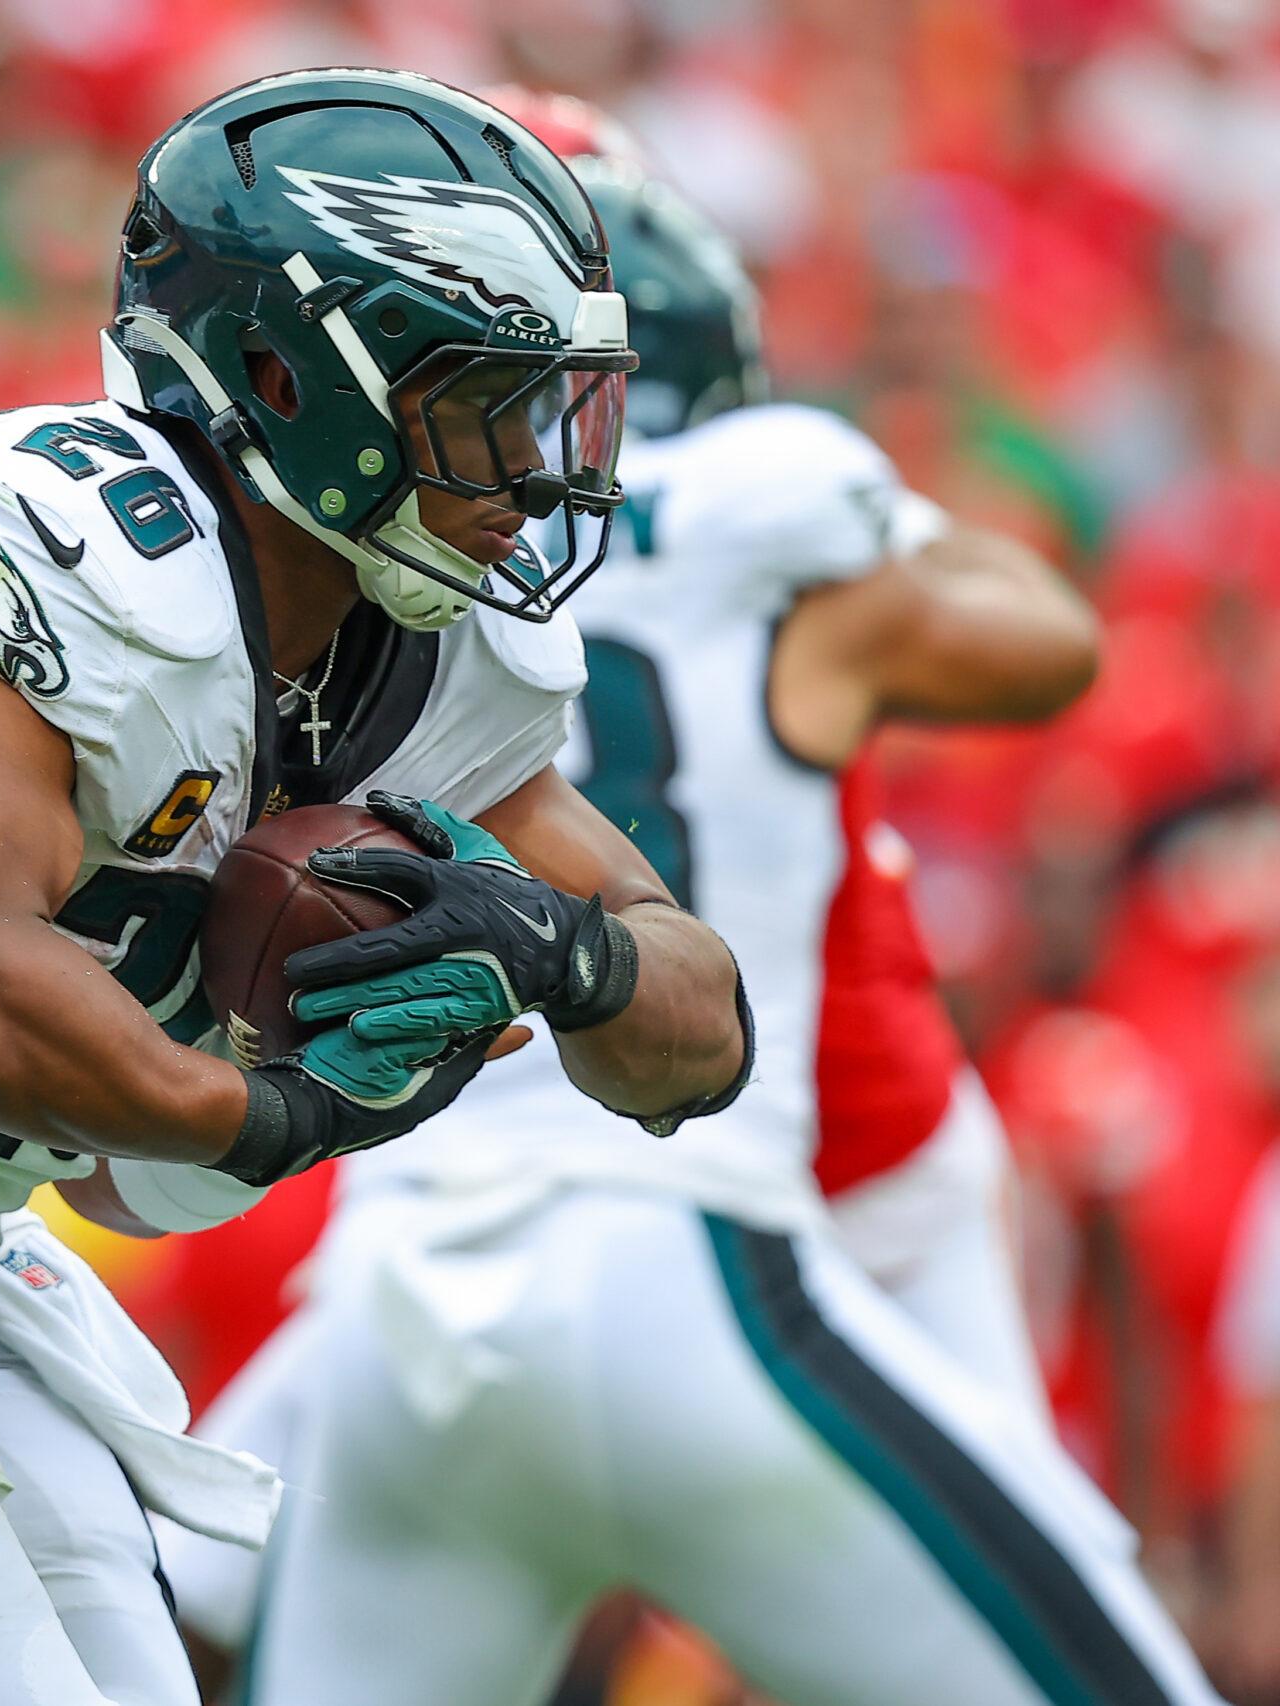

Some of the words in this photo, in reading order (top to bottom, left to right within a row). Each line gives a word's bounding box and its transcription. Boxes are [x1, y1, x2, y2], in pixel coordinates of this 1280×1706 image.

[496, 325, 560, 346] OAKLEY
[11, 416, 206, 561] 26
[150, 778, 213, 836] C
